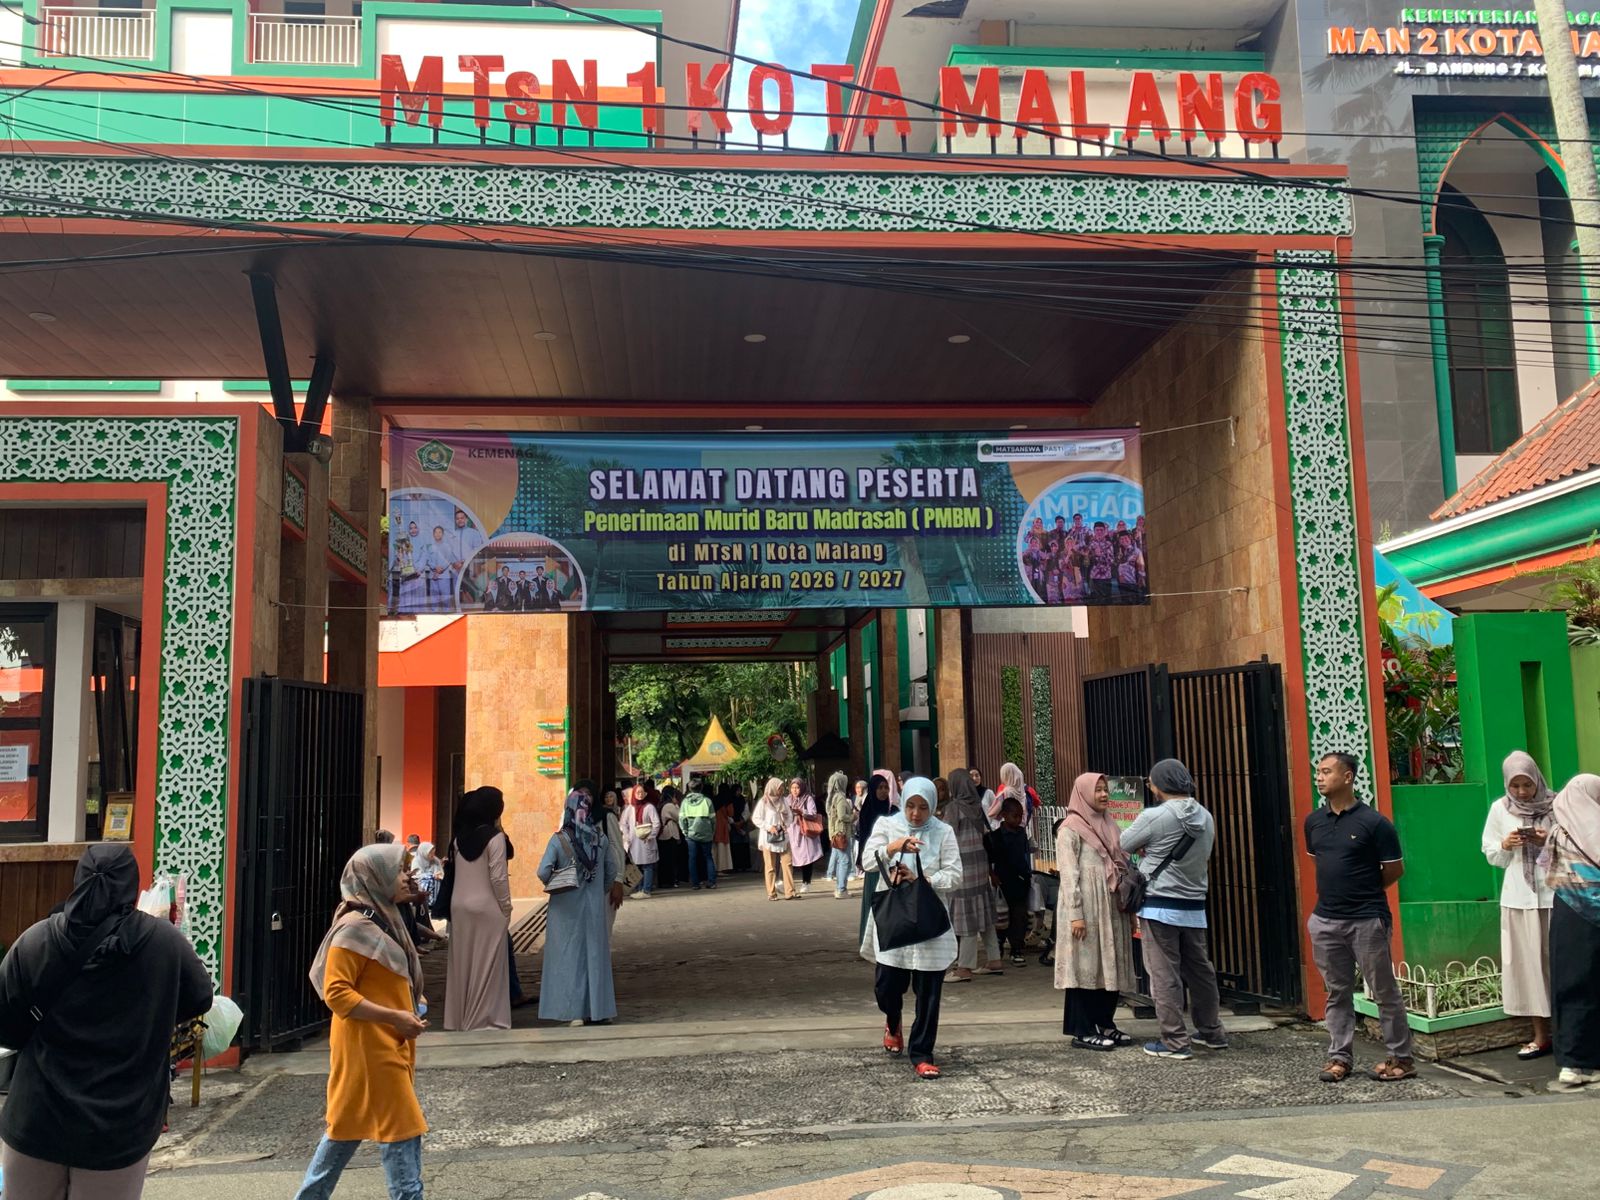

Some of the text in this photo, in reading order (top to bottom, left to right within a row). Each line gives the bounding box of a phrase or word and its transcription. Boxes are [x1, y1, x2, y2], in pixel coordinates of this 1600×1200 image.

[1327, 26, 1411, 54] MAN
[1417, 28, 1438, 54] 2
[1445, 28, 1543, 56] KOTA
[1425, 62, 1509, 76] BANDUNG
[380, 54, 1284, 144] MTsN 1 KOTA MALANG
[468, 448, 534, 458] KEMENAG
[994, 445, 1041, 453] MATSANEWA
[589, 467, 978, 500] SELAMAT DATANG PESERTA
[584, 509, 699, 532] Penerimaan
[704, 508, 760, 531] Murid
[765, 508, 808, 531] Baru
[813, 507, 907, 530] Madrasah
[924, 506, 980, 529] PMBM
[668, 542, 884, 562] di MTsN 1 Kota Malang
[656, 569, 903, 592] Tahun Ajaran 2026 / 2027
